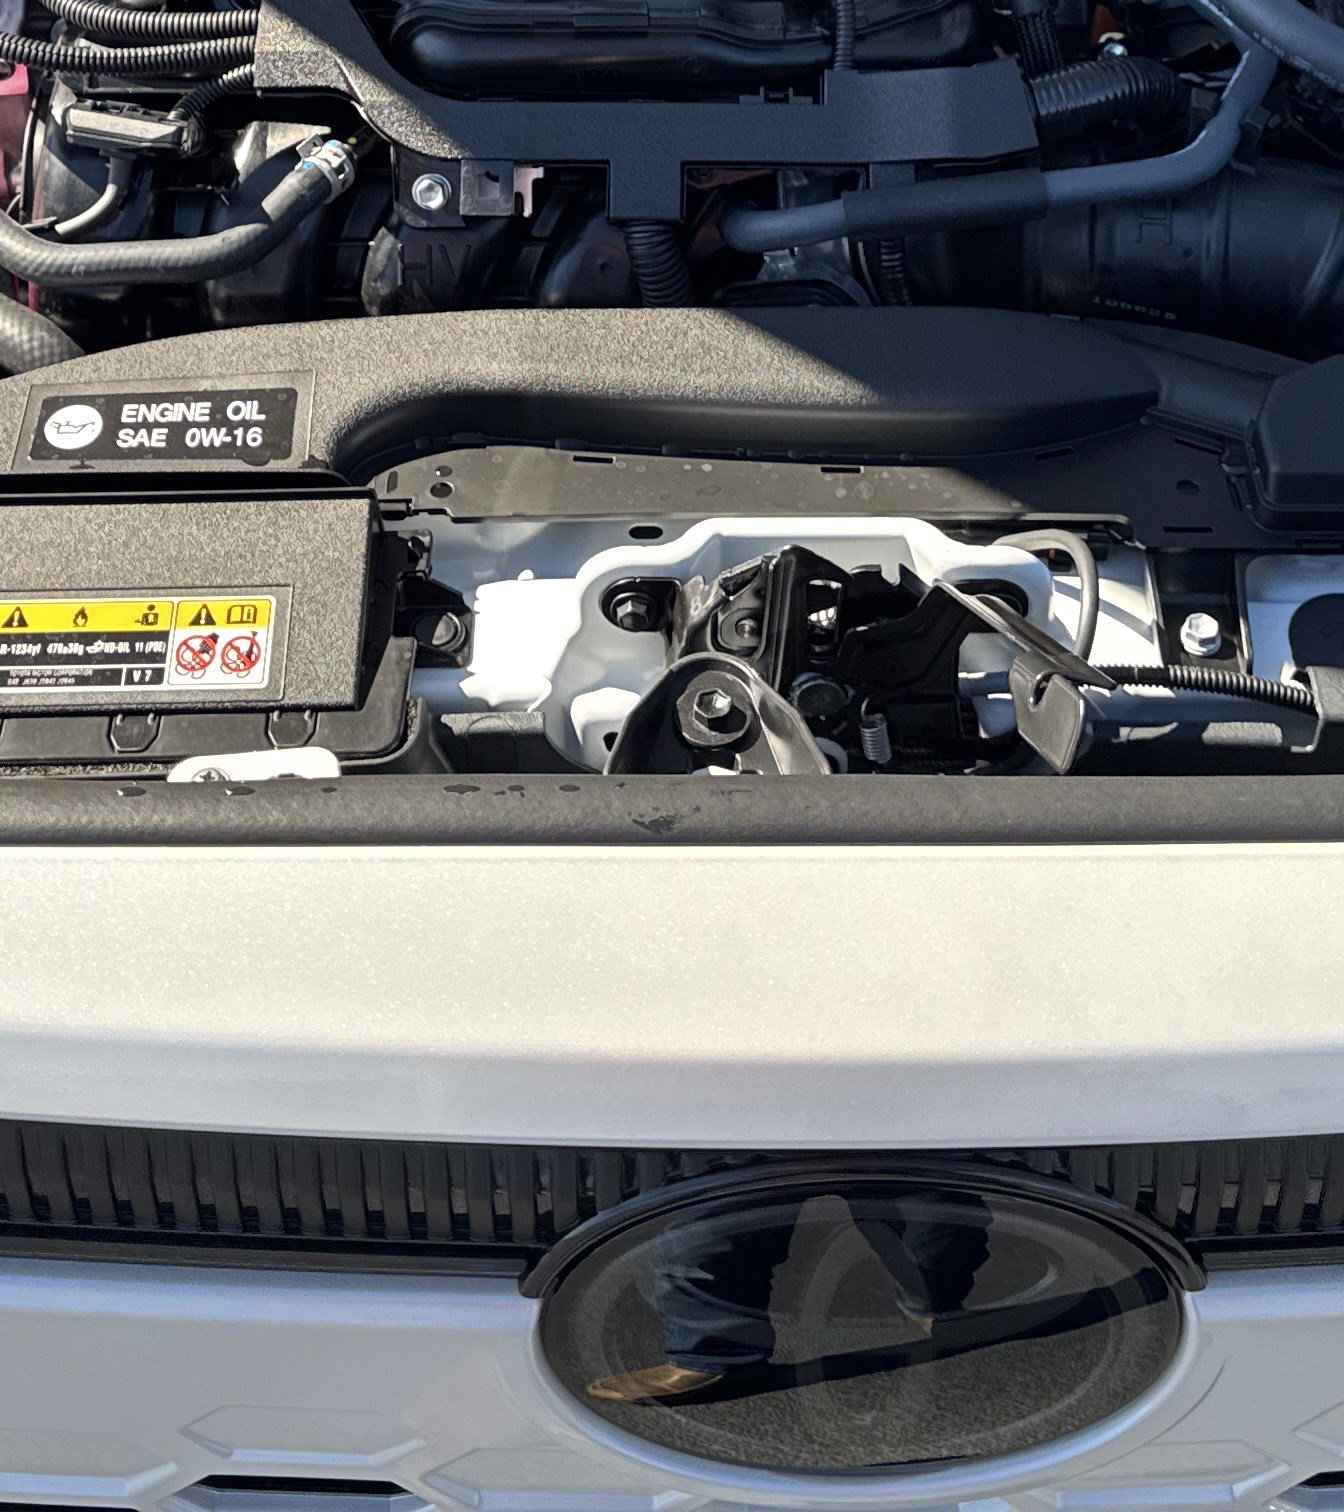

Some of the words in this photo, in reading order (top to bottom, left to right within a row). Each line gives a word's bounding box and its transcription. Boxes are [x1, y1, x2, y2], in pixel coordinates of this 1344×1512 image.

[120, 402, 212, 423] ENGINE
[226, 400, 266, 421] OIL
[116, 428, 168, 448] SAE
[185, 427, 263, 447] 0W-16
[0, 643, 42, 656] R-1234yf
